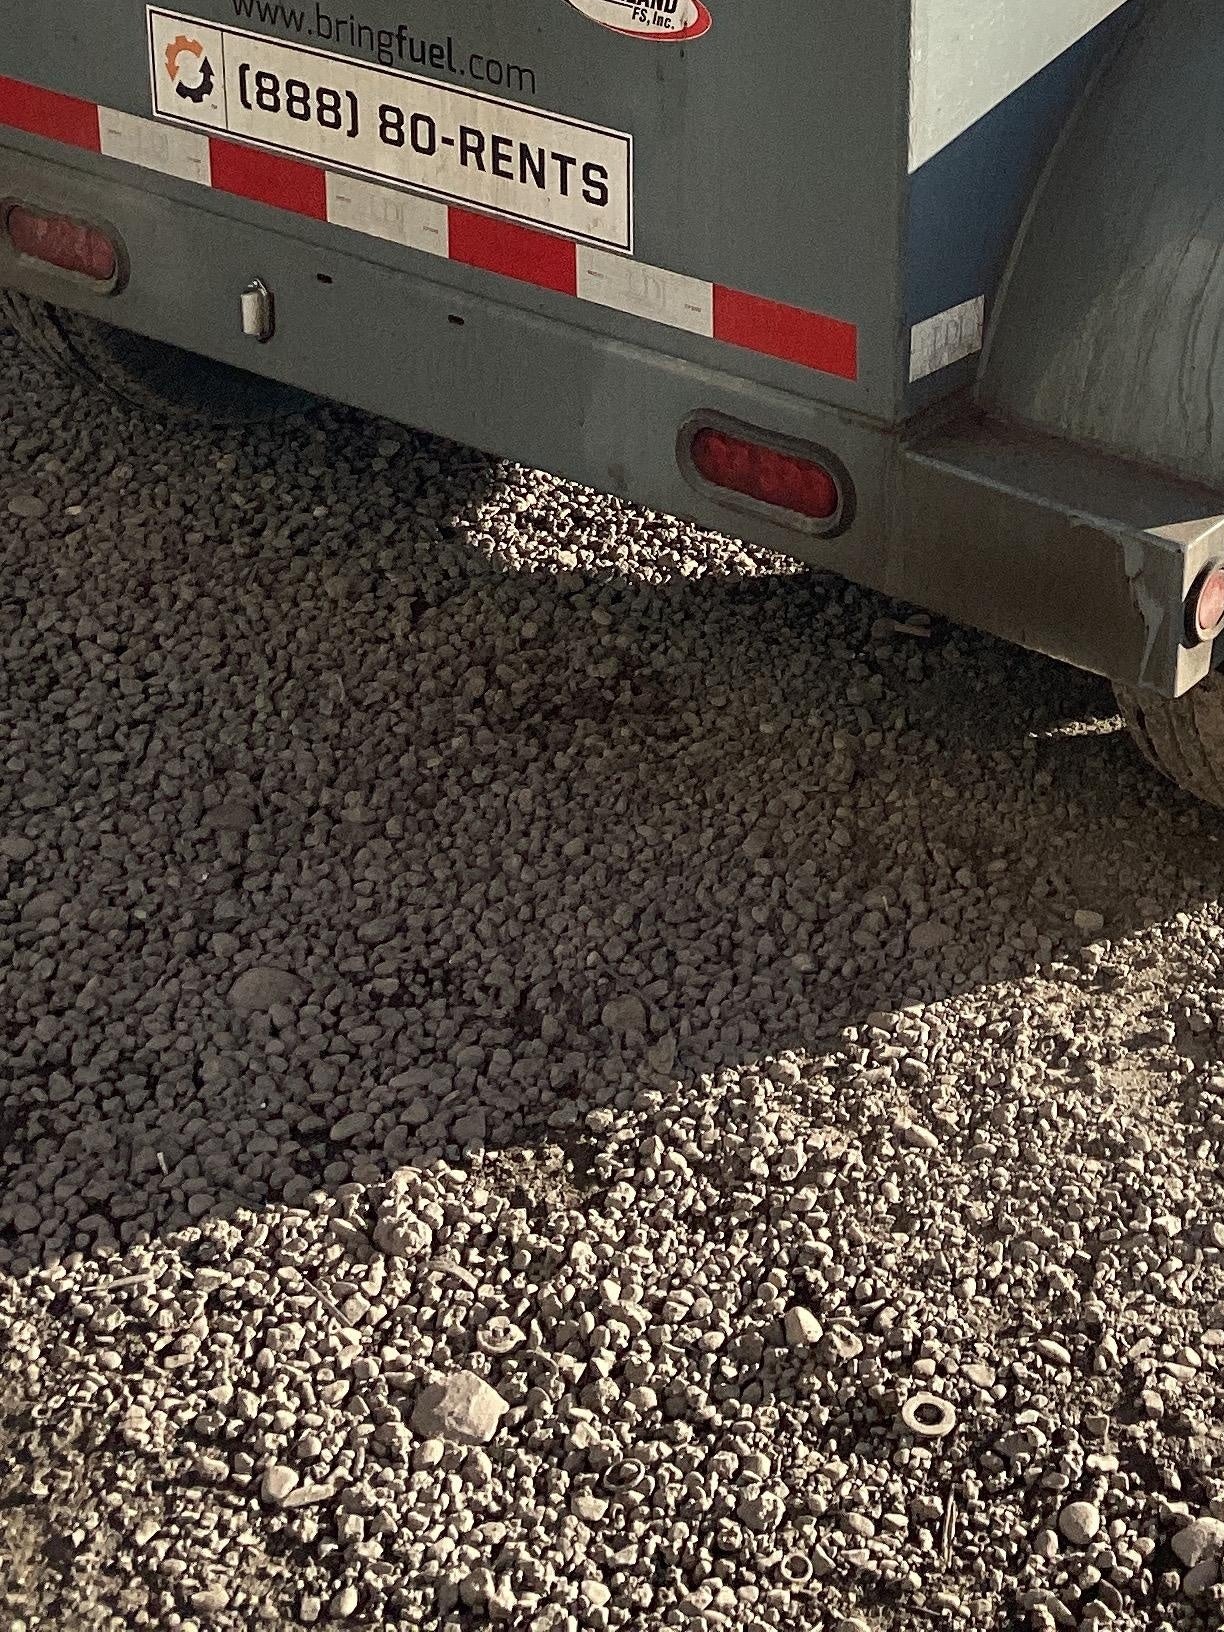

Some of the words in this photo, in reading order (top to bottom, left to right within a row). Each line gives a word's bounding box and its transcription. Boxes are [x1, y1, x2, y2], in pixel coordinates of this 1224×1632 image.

[652, 10, 676, 30] Inc.
[238, 63, 359, 139] (888)
[378, 104, 610, 208] 80-RENTS
